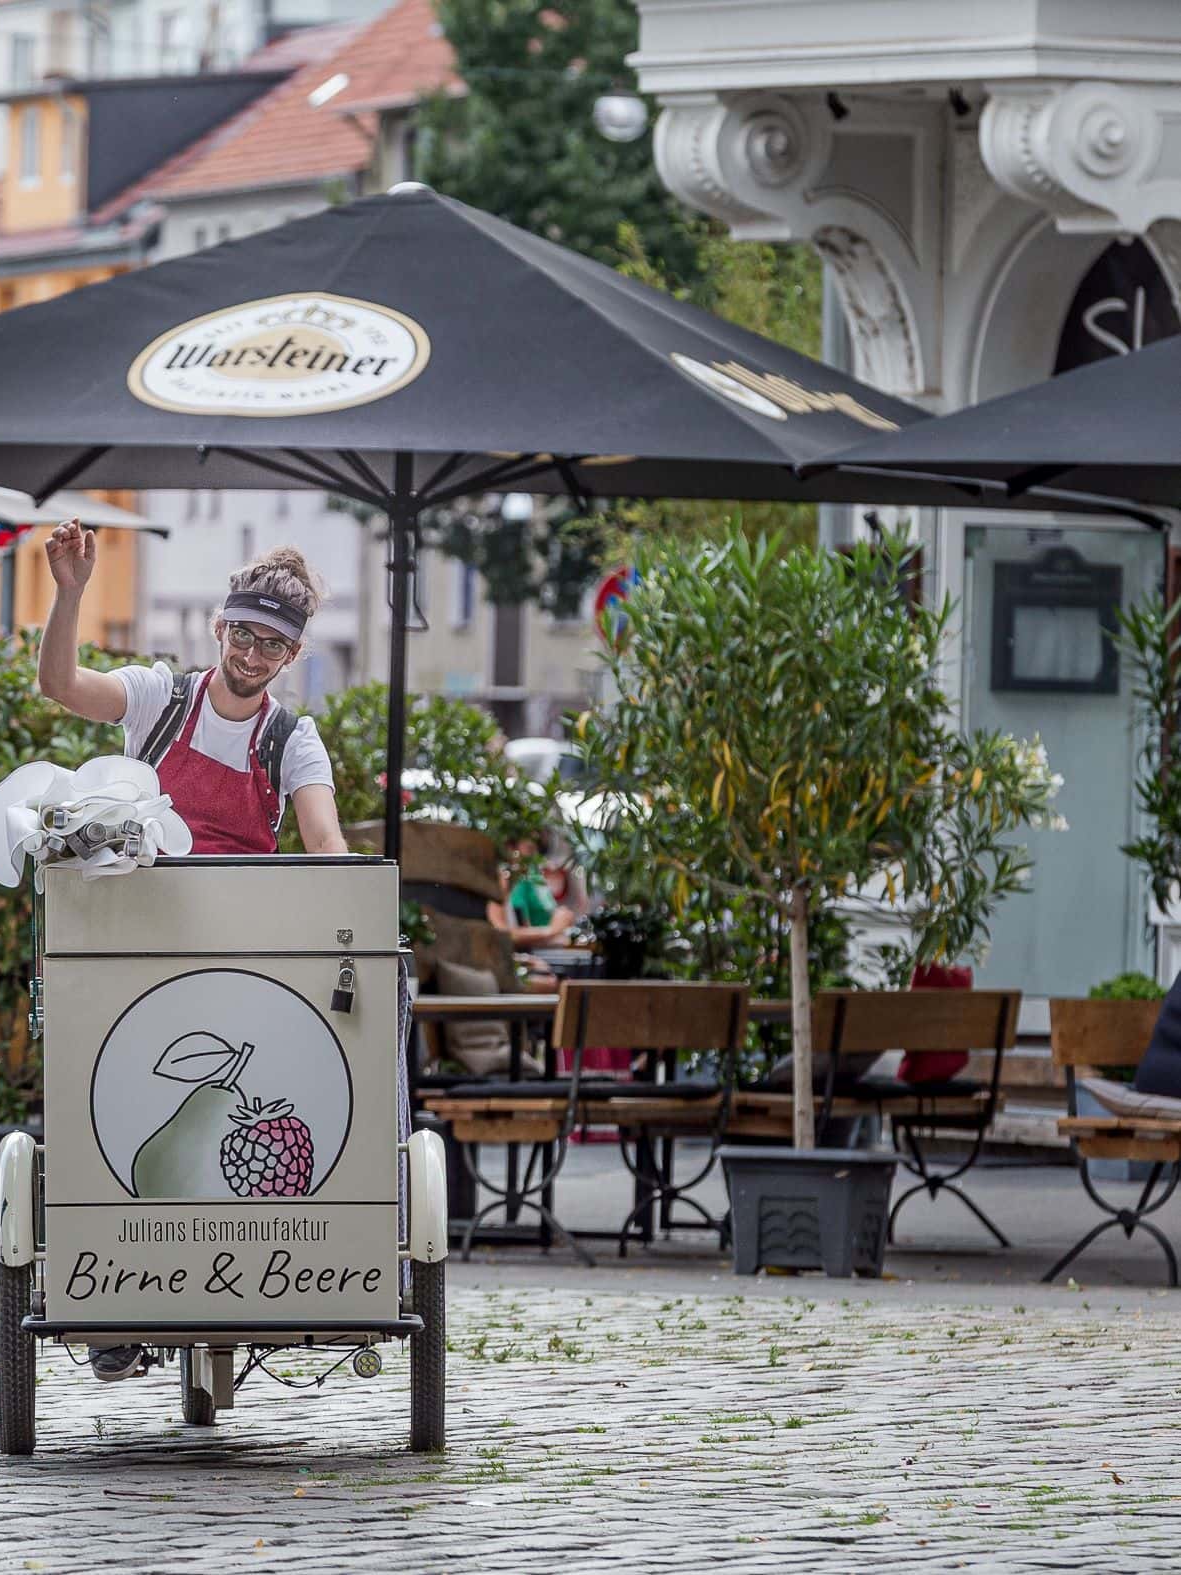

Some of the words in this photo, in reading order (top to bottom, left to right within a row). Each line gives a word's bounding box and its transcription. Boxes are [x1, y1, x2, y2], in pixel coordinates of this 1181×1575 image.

[165, 335, 398, 377] Warsteiner
[117, 1218, 186, 1243] Julians
[193, 1217, 330, 1242] Eismanufaktur
[65, 1251, 188, 1300] Birne
[204, 1251, 244, 1299] &
[259, 1250, 382, 1299] Beere
